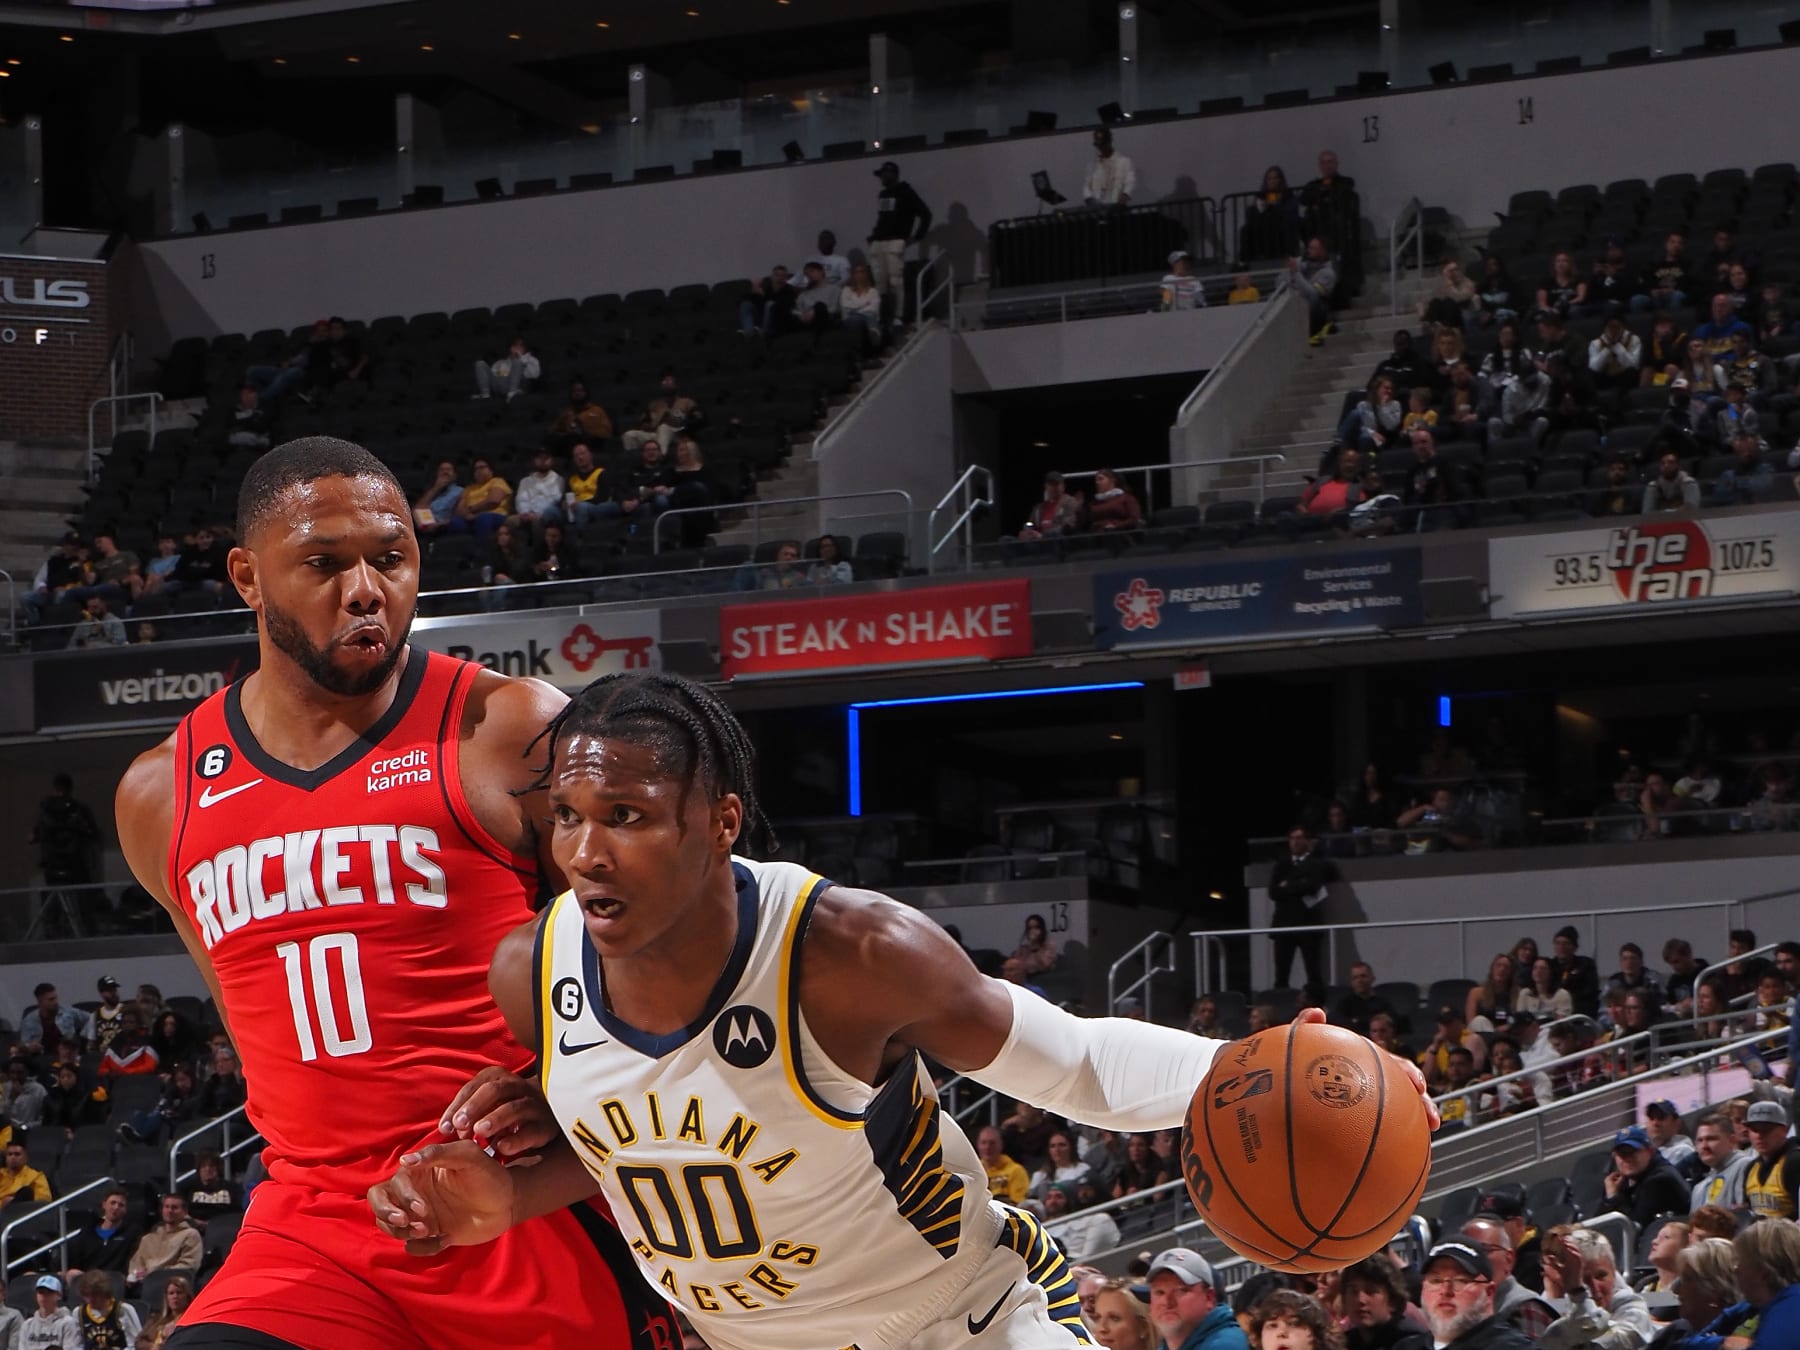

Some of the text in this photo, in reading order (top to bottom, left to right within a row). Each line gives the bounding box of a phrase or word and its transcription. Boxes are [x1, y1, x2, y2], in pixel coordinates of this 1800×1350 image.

[1517, 95, 1534, 125] 14
[1362, 115, 1380, 143] 13
[201, 253, 217, 280] 13
[0, 276, 91, 308] US
[1607, 527, 1689, 571] the
[1303, 562, 1392, 581] Environmental
[1321, 578, 1374, 593] Services
[1554, 539, 1774, 602] 93.5 fan 107.5
[1168, 581, 1263, 603] REPUBLIC
[1188, 599, 1241, 613] SERVICES
[1293, 597, 1350, 615] Recycling
[1364, 594, 1402, 607] Waste
[731, 603, 1013, 660] STEAK N SHAKE
[101, 668, 225, 706] verizon
[203, 748, 225, 777] 6
[370, 749, 429, 775] credit
[366, 767, 432, 794] karma
[185, 823, 448, 951] ROCKETS
[1050, 902, 1069, 933] 13
[275, 931, 374, 1062] 10
[560, 982, 581, 1018] 6
[614, 1161, 765, 1262] 00
[630, 1236, 821, 1314] PACERS
